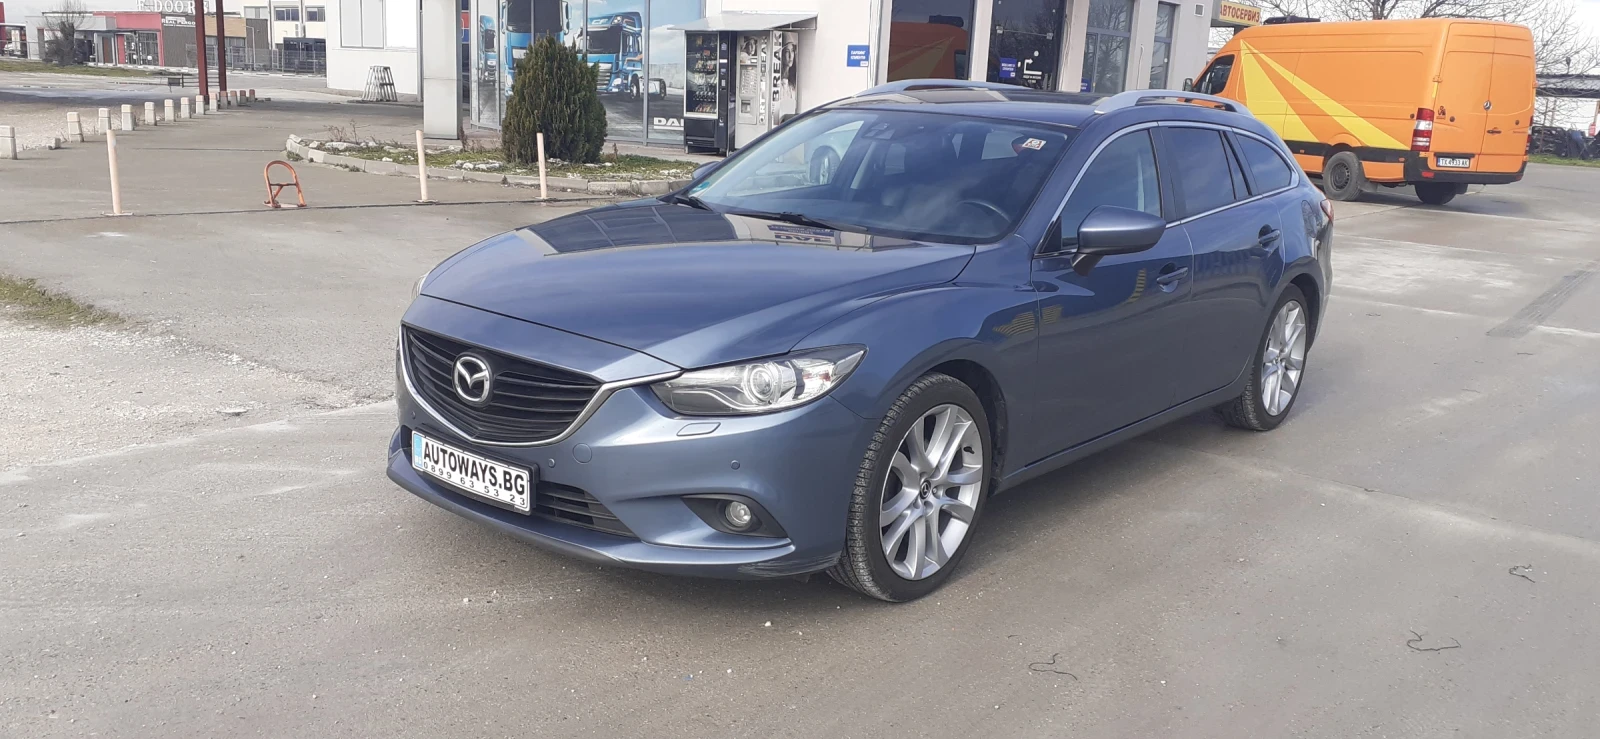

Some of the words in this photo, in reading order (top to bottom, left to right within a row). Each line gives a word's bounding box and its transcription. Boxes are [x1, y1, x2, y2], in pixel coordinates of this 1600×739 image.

[772, 32, 782, 102] BREAK
[423, 441, 525, 496] AUTOWAYS.BG
[423, 462, 452, 479] 0899
[460, 477, 475, 489] 63
[484, 486, 500, 497] 53
[509, 494, 526, 506] 23
